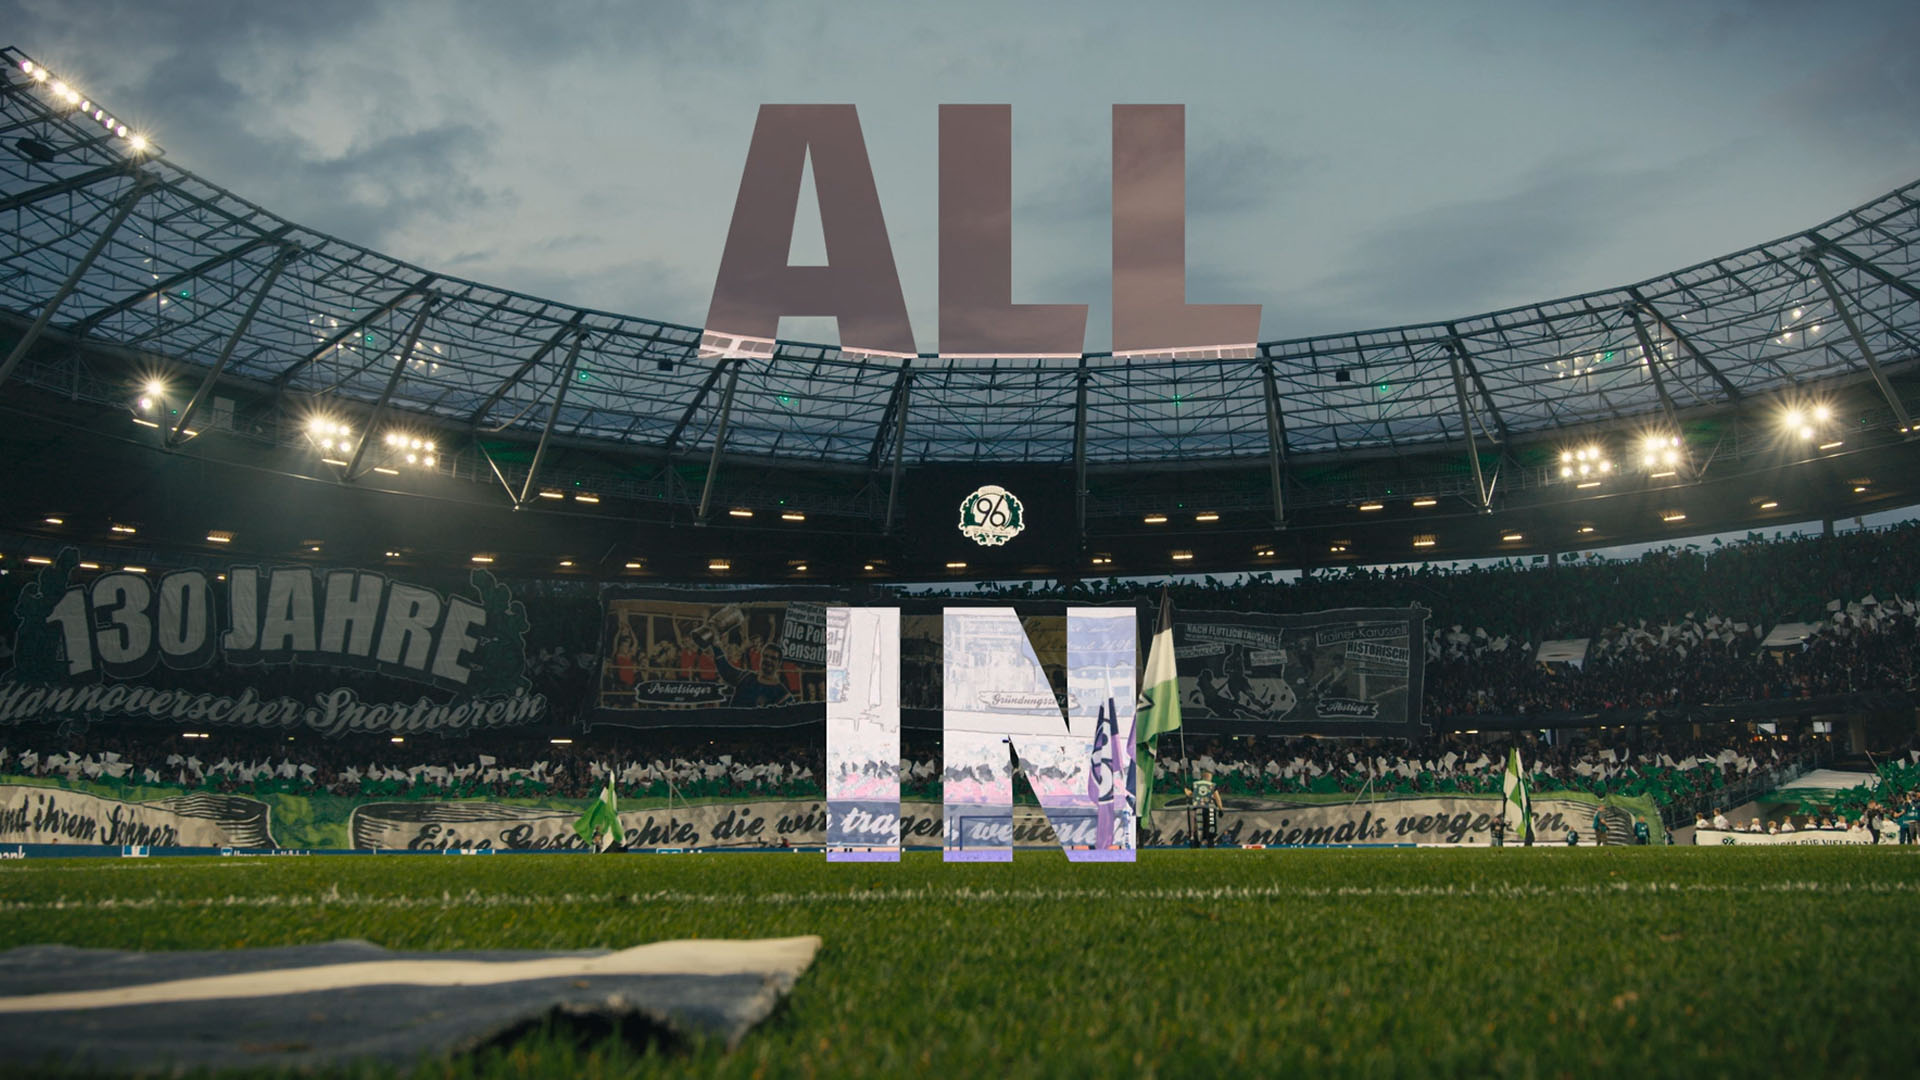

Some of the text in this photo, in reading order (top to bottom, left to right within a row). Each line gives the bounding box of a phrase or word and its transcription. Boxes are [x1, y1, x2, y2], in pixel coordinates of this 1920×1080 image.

[976, 498, 1006, 527] 96
[46, 566, 487, 684] 130 JAHRE
[784, 621, 804, 640] Die
[1186, 623, 1208, 635] NACH
[1319, 624, 1408, 643] Trainer-Karussell
[782, 638, 840, 664] Sensation
[1347, 640, 1409, 660] HISTORISCH!
[648, 683, 712, 697] Pokalsieger
[0, 681, 544, 736] Hannoverscher Sportverein
[0, 794, 31, 834] nd
[34, 794, 97, 841] ihrem
[408, 817, 493, 850] Eine
[500, 816, 700, 850] Gescchte,
[711, 807, 766, 841] die
[775, 803, 833, 835] wir
[1247, 810, 1387, 845] niemals
[0, 845, 26, 859] ank
